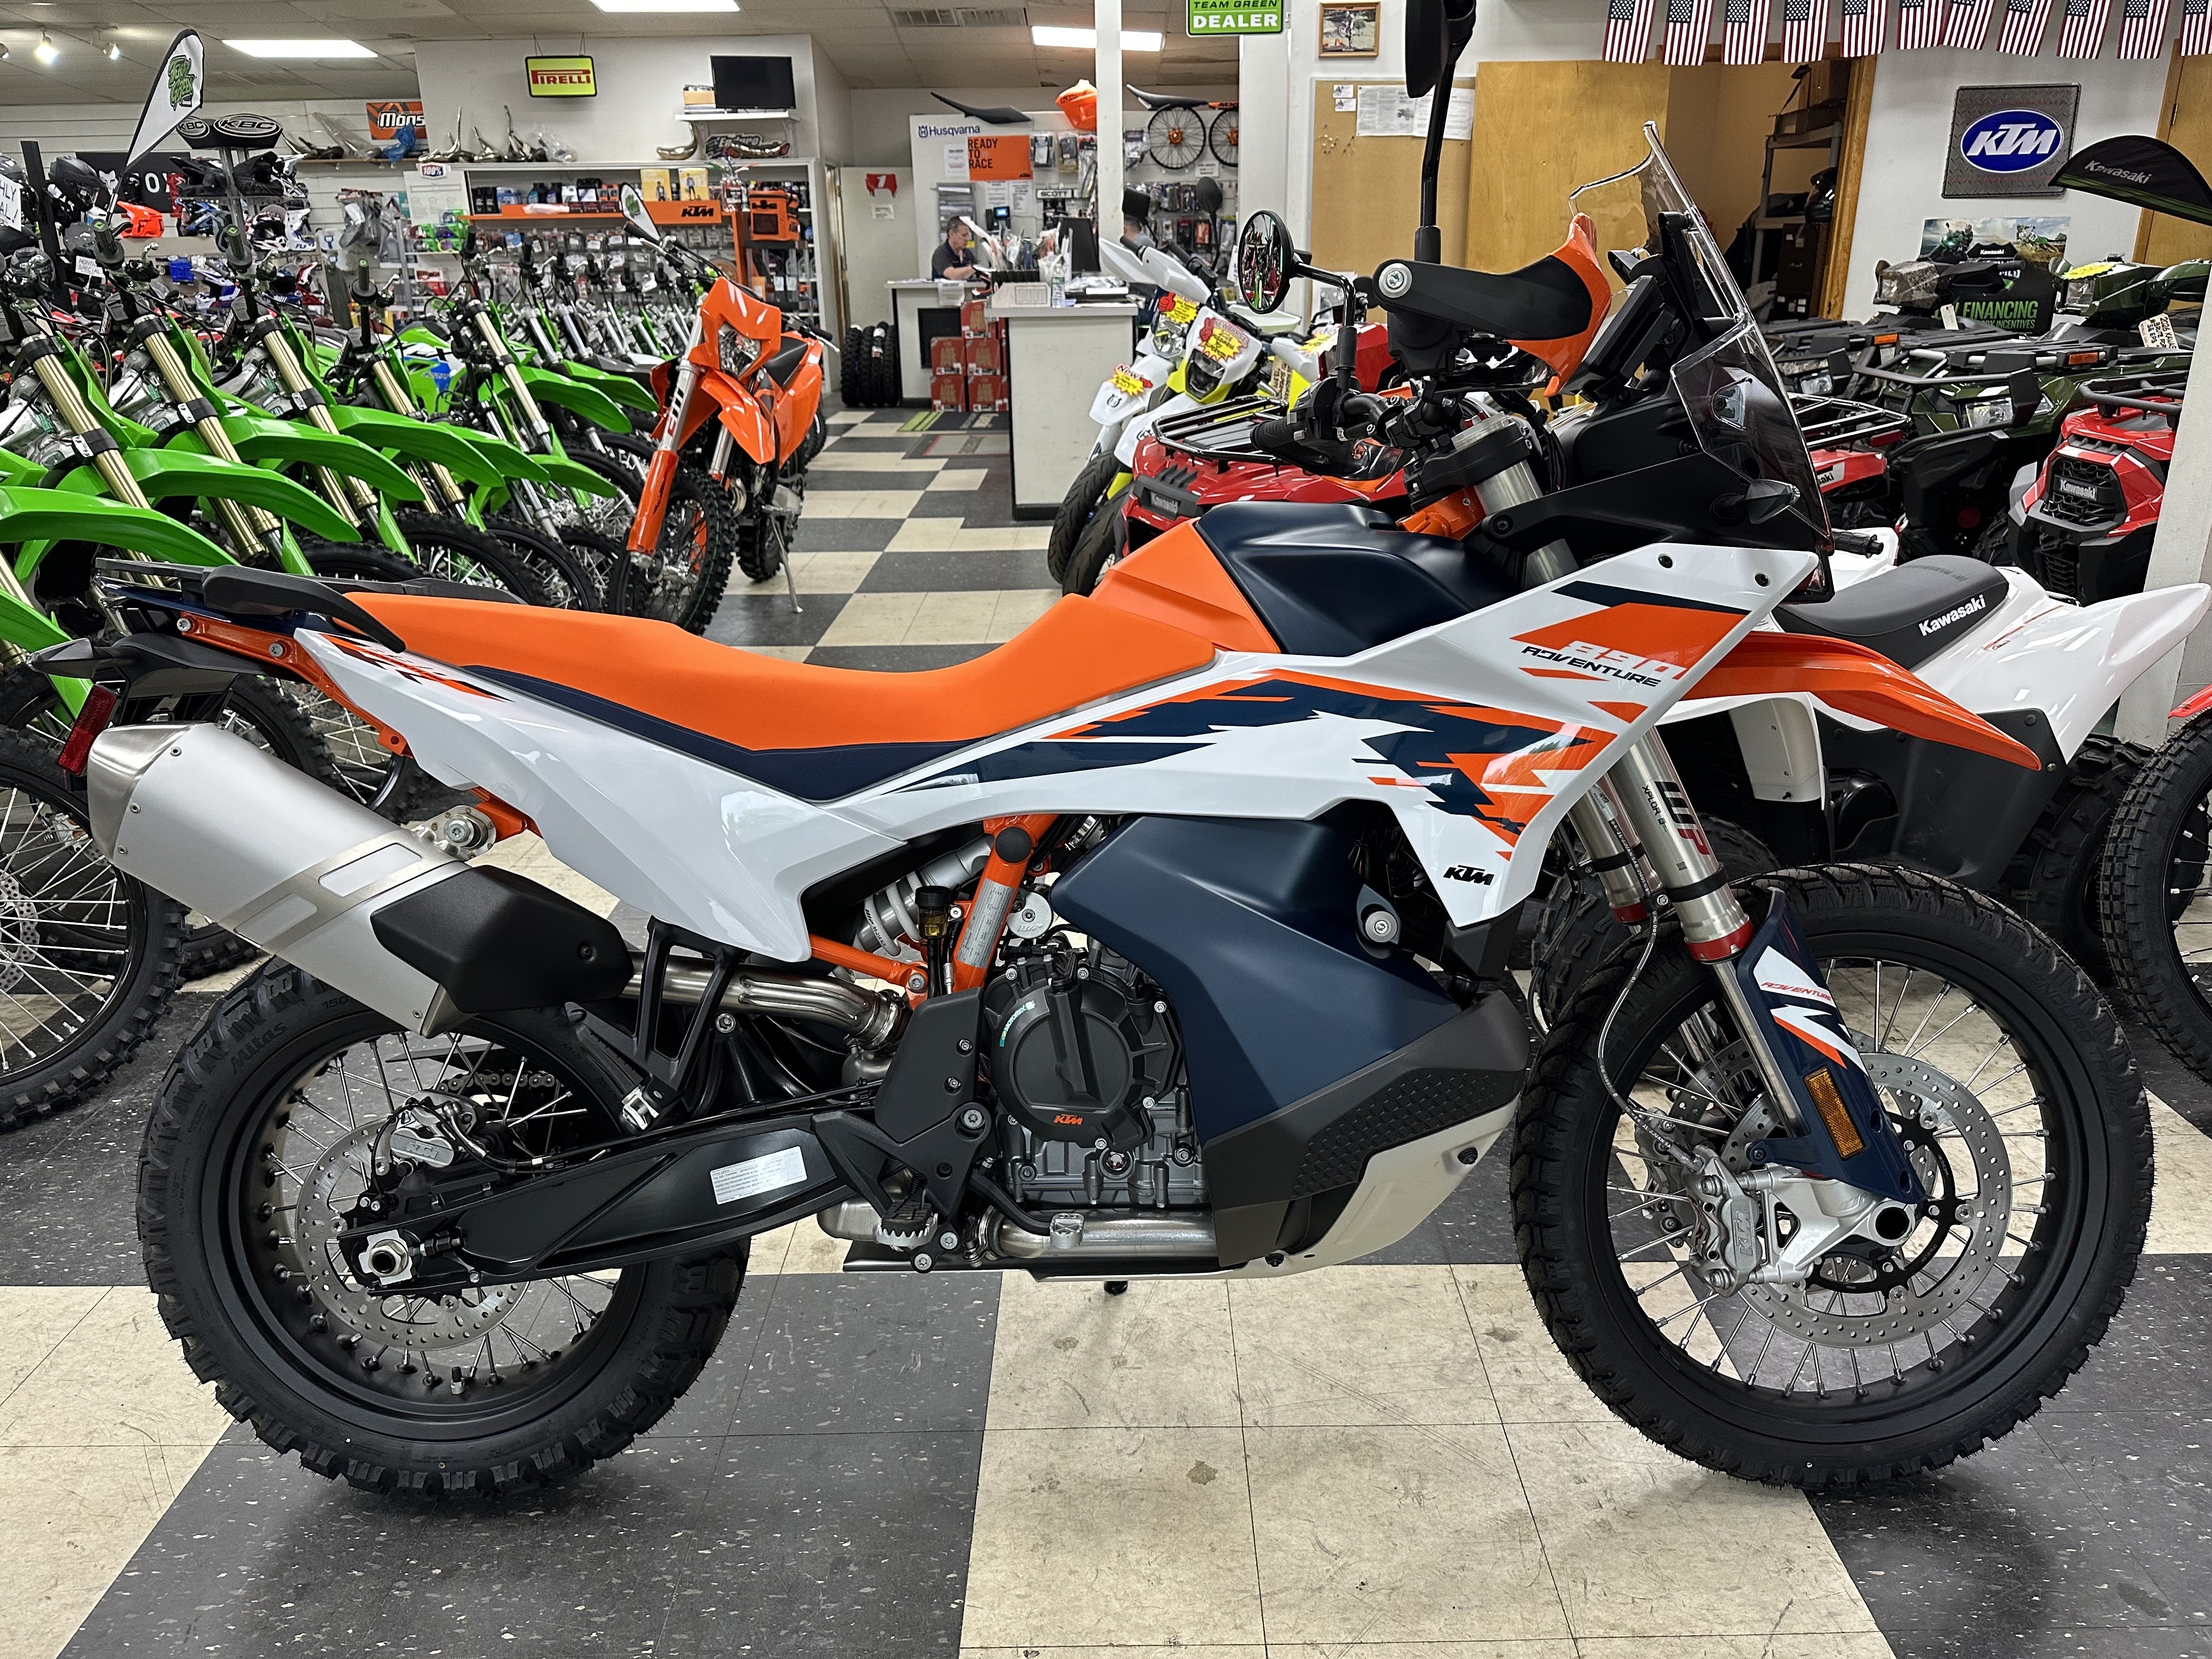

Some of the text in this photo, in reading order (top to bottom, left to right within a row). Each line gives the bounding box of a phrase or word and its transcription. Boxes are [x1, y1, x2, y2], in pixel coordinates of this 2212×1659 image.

[1193, 14, 1278, 28] DEALER
[168, 55, 191, 88] TEAM
[531, 69, 591, 84] PIRELLI
[178, 121, 204, 131] KBC
[219, 120, 276, 129] KBC
[929, 126, 980, 136] Husqvarna
[968, 138, 998, 149] READY
[1966, 123, 2057, 156] KTM
[968, 149, 980, 159] TO
[423, 166, 442, 176] 100%
[969, 159, 993, 169] RACE
[2084, 160, 2152, 184] Kawasaki
[681, 206, 714, 217] KTM
[1963, 301, 2039, 319] FINANCING
[1996, 319, 2035, 329] INCENTIVES
[2060, 479, 2096, 499] Kawasaki
[1918, 594, 1986, 636] Kawasaki
[1521, 646, 1661, 687] ADVENTURE
[1641, 785, 1662, 816] XPLOR
[1443, 865, 1495, 886] KTM
[1760, 982, 1832, 1001] ADVENTURE
[1005, 1004, 1027, 1032] MOTOREX
[231, 1022, 287, 1075] Mitas
[1053, 1114, 1084, 1125] KTM
[1734, 1210, 1753, 1256] KTM
